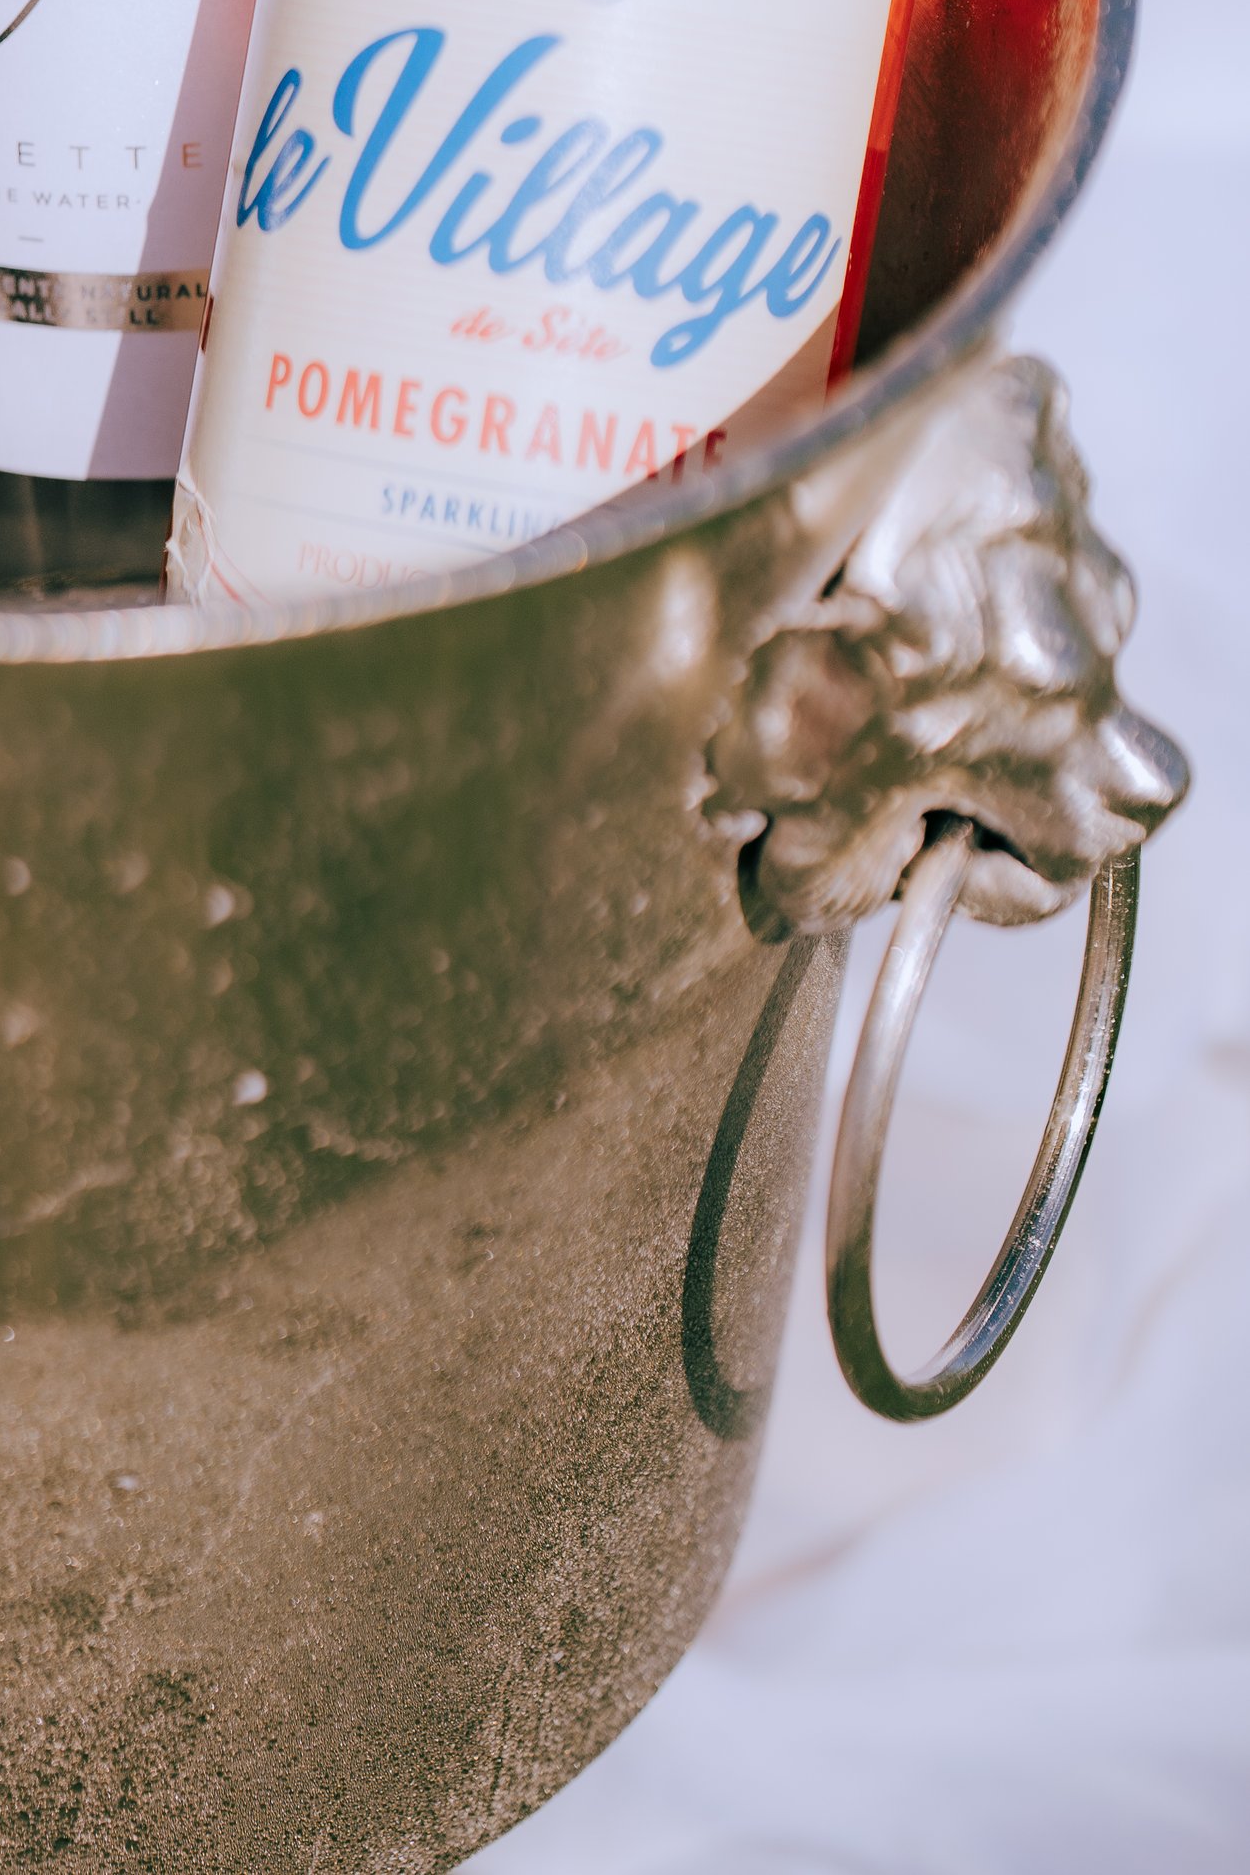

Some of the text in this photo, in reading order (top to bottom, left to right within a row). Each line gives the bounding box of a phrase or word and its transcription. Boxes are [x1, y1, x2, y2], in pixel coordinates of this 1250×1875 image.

[236, 26, 842, 367] le Village
[449, 305, 514, 343] de
[381, 486, 560, 539] SPARKLIN
